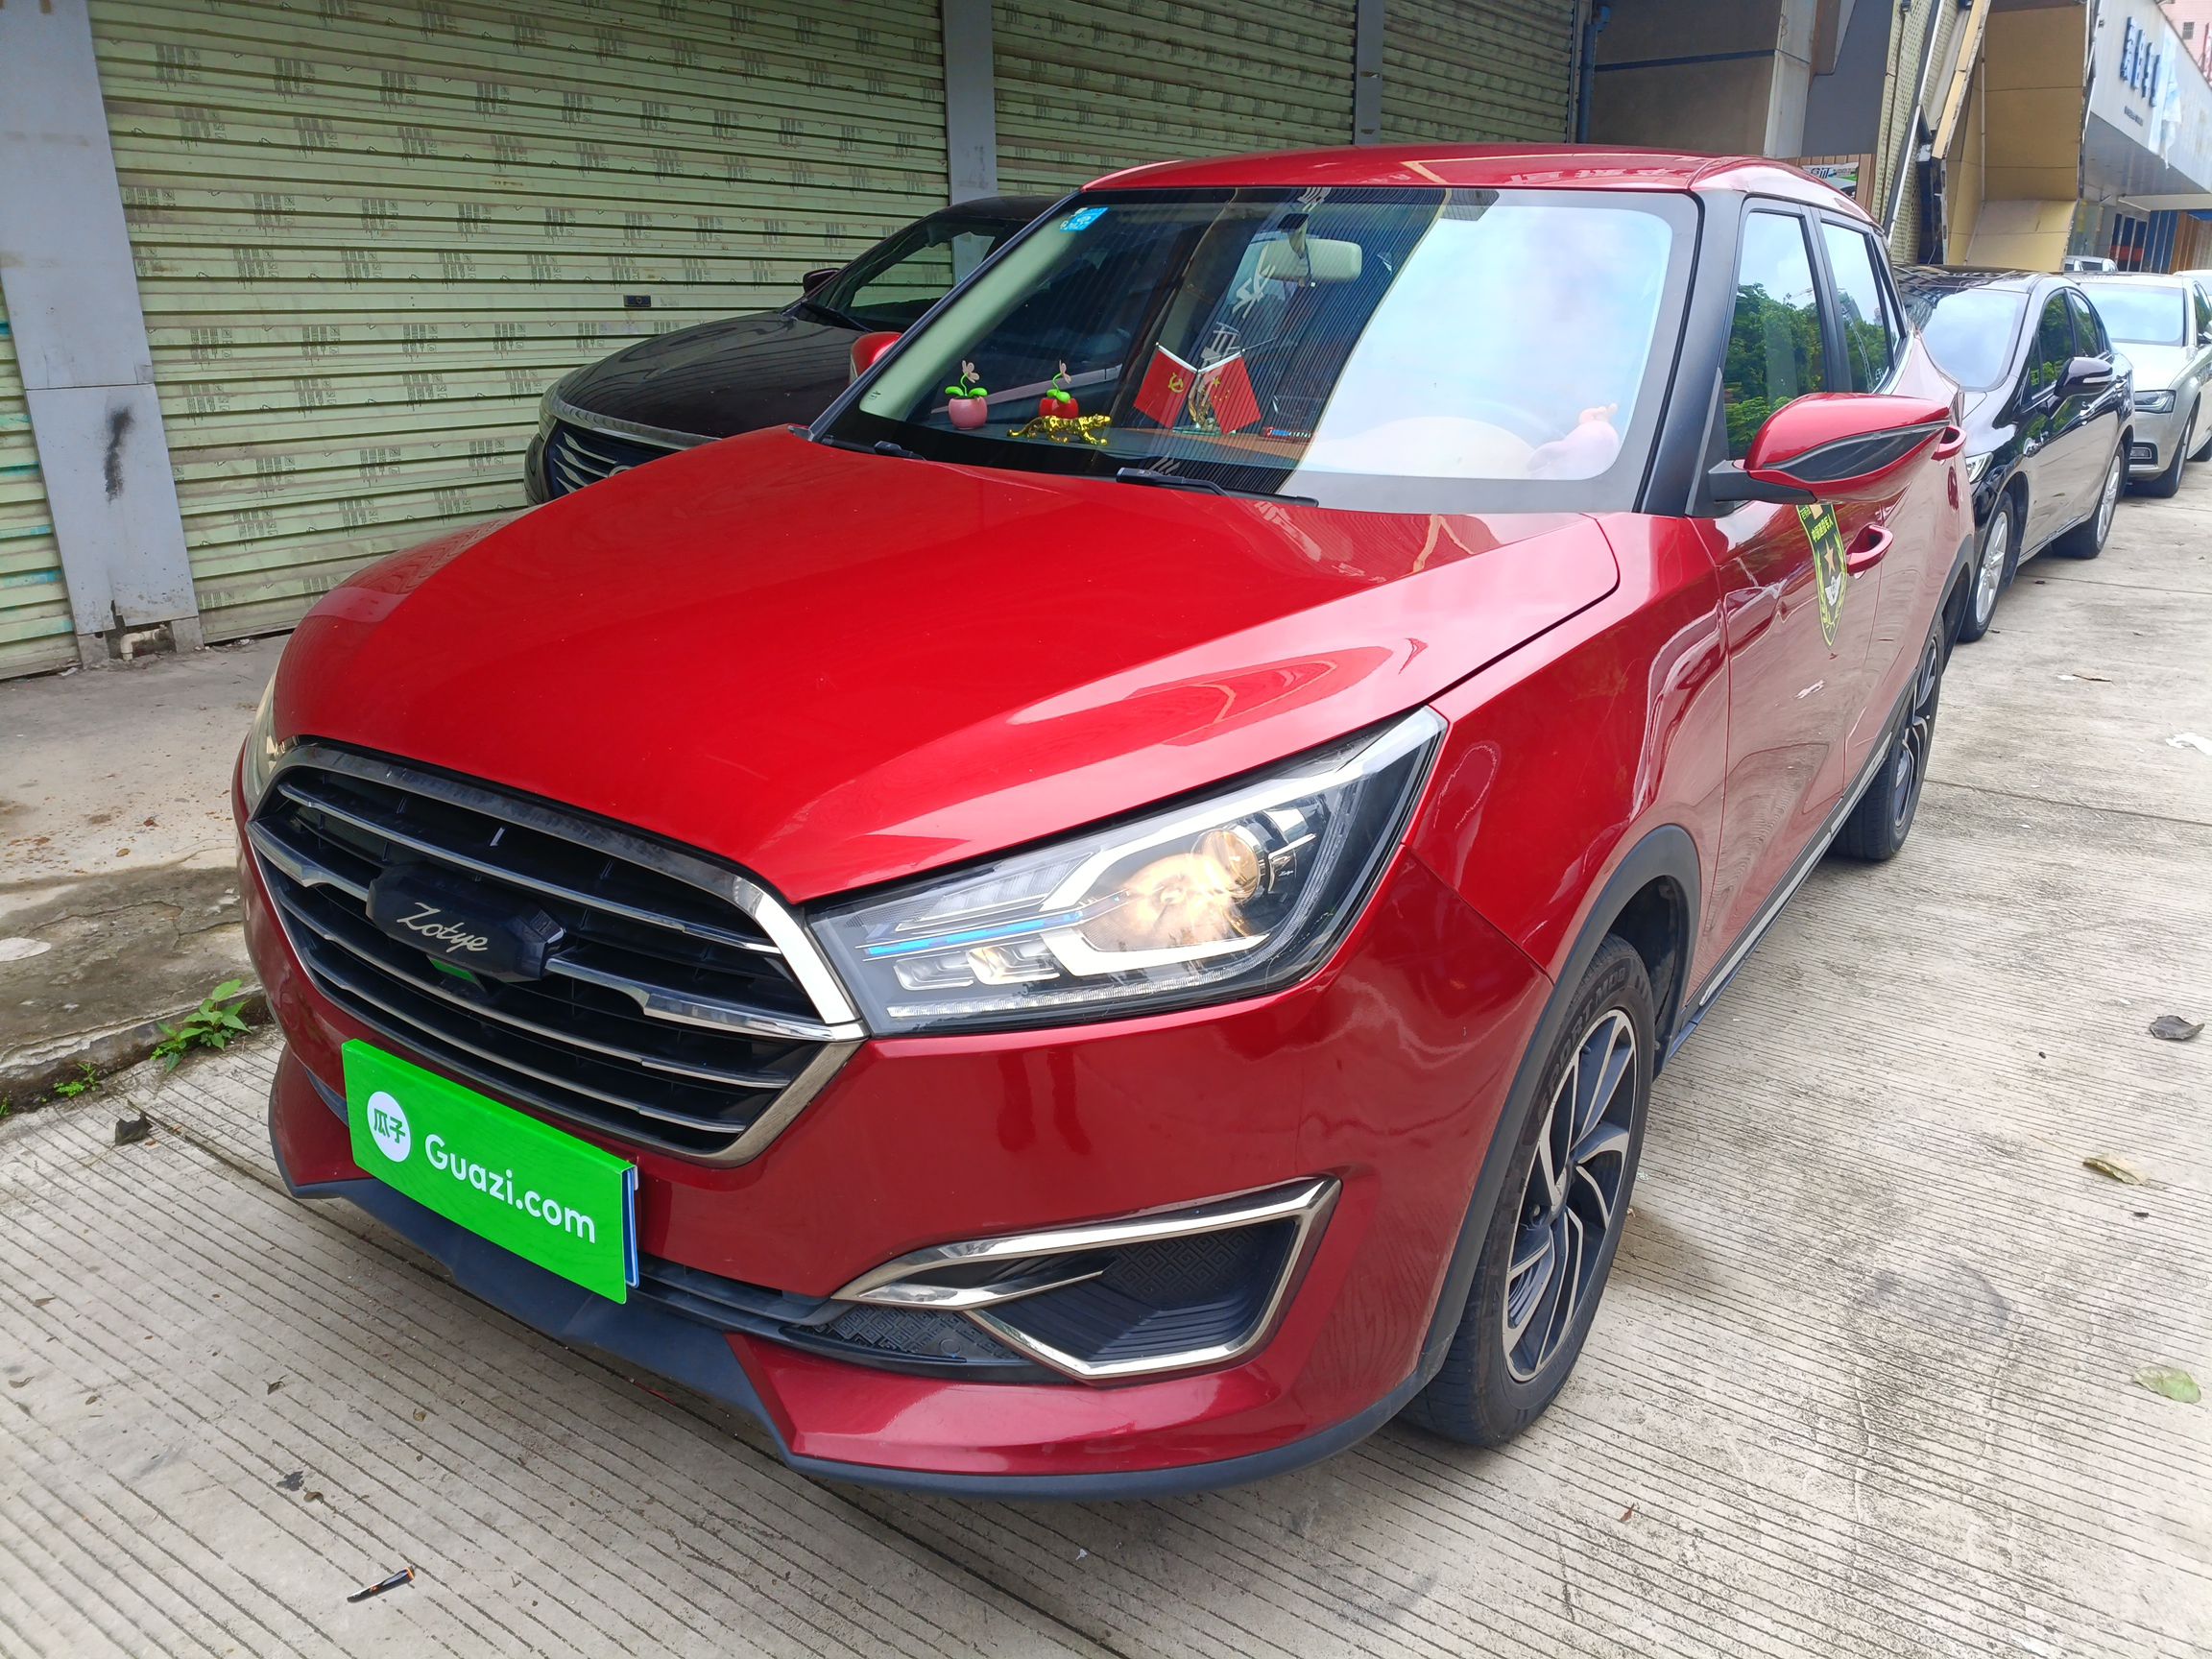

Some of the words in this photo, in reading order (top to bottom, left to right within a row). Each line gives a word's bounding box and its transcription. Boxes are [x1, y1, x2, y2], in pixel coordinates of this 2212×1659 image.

[396, 902, 489, 953] Zotye
[373, 1108, 406, 1143] 瓜子
[424, 1134, 596, 1244] Guazi.com
